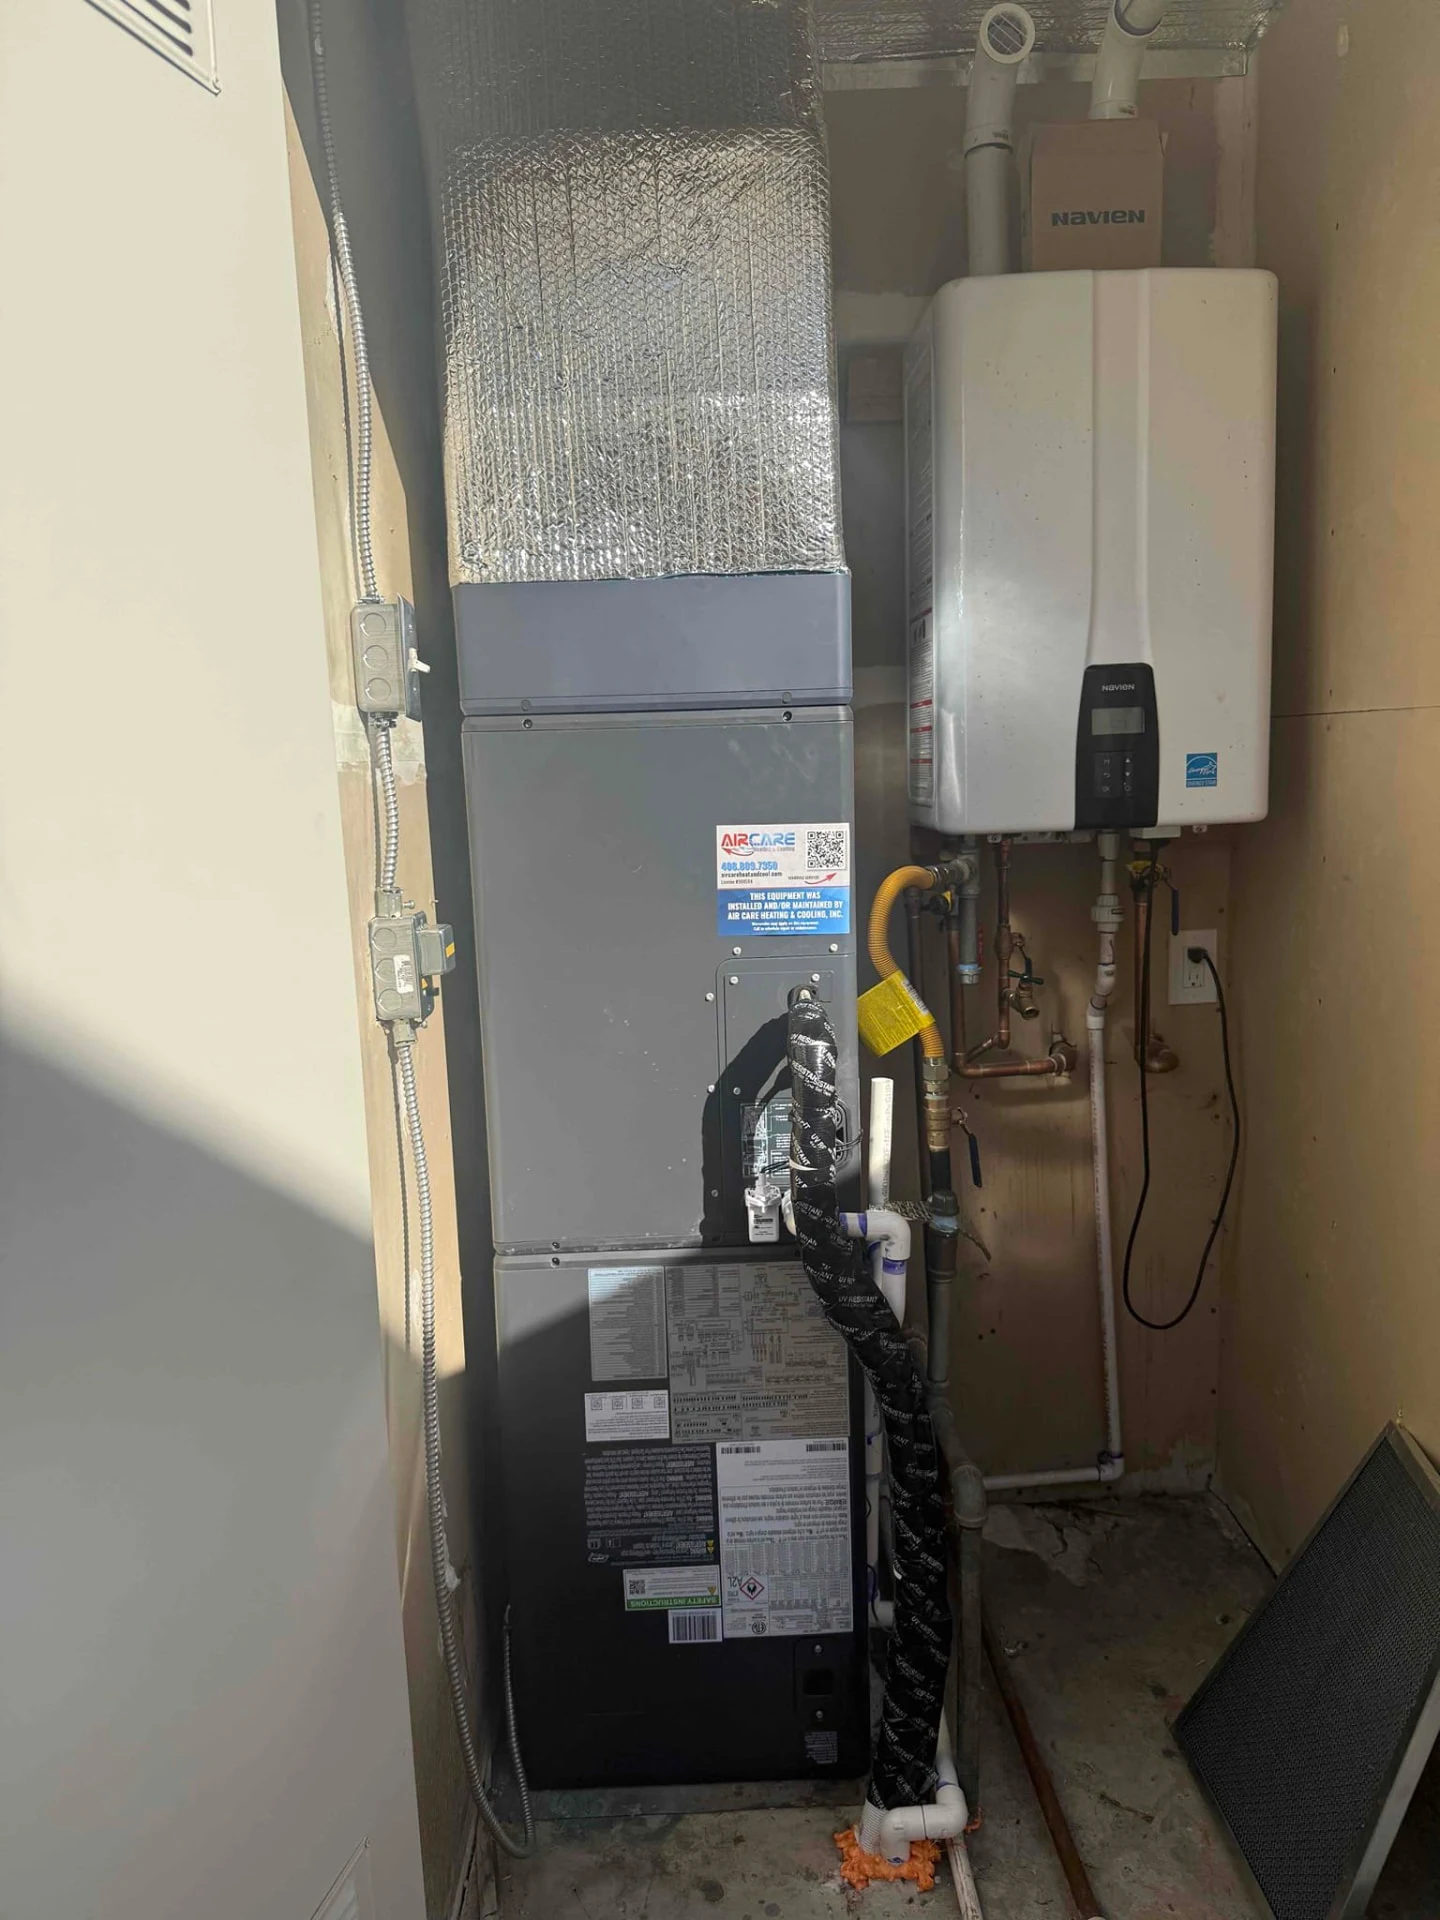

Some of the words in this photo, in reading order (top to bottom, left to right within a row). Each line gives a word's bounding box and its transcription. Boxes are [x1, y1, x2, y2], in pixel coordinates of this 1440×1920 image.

[721, 832, 796, 847] AIRCARE
[750, 892, 766, 900] THIS
[767, 891, 804, 901] EQUIPMENT
[806, 891, 821, 899] WAS
[728, 902, 762, 910] INSTALLED
[764, 902, 791, 910] AND/OR
[792, 901, 833, 909] MAINTAINED
[834, 900, 843, 908] BY
[728, 912, 740, 920] AIR
[741, 911, 759, 920] CARE
[761, 911, 788, 919] HEATING
[791, 911, 795, 919] &
[797, 910, 828, 919] COOLING,
[829, 910, 844, 919] INC.
[727, 1576, 743, 1588] A2L
[630, 1598, 686, 1608] INSTRUCTIONS
[687, 1597, 717, 1605] SAFETY
